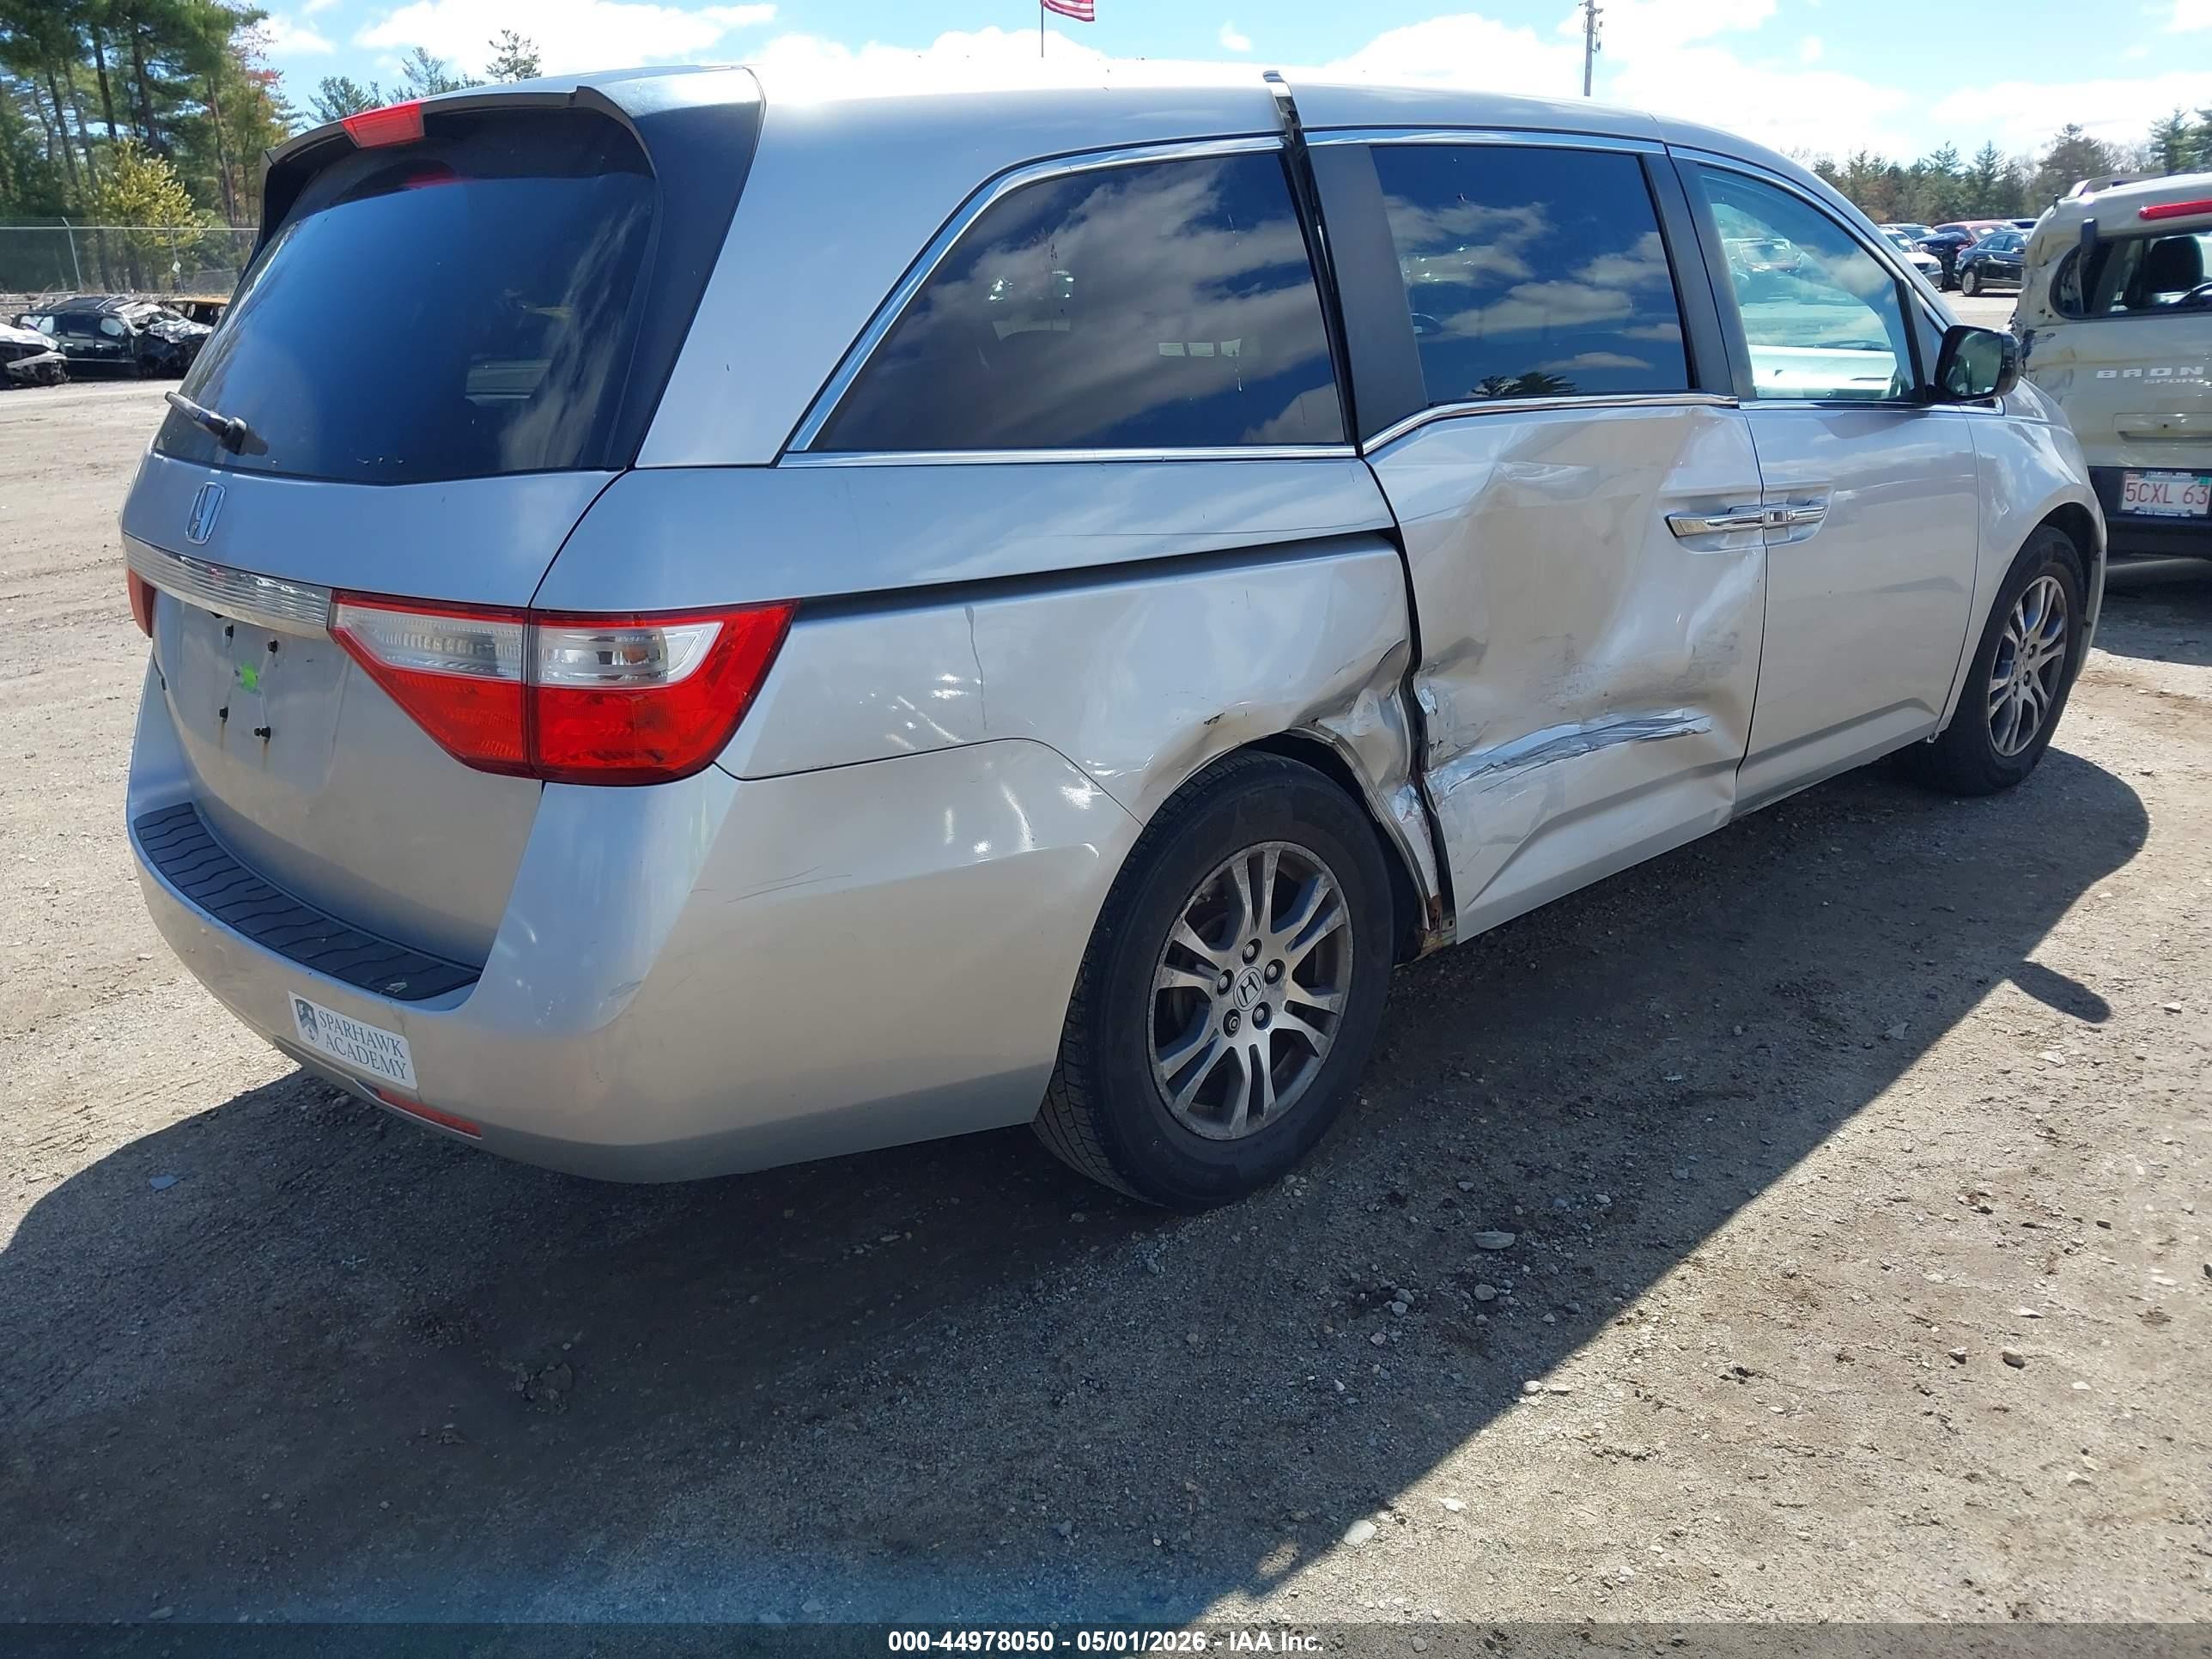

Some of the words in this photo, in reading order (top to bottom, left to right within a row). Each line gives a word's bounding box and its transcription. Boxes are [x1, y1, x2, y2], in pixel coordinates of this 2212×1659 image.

[2125, 482, 2173, 504] 5CXL
[2183, 484, 2209, 505] 63
[318, 1010, 405, 1059] SPARHAWK
[325, 1033, 406, 1079] ACADEMY
